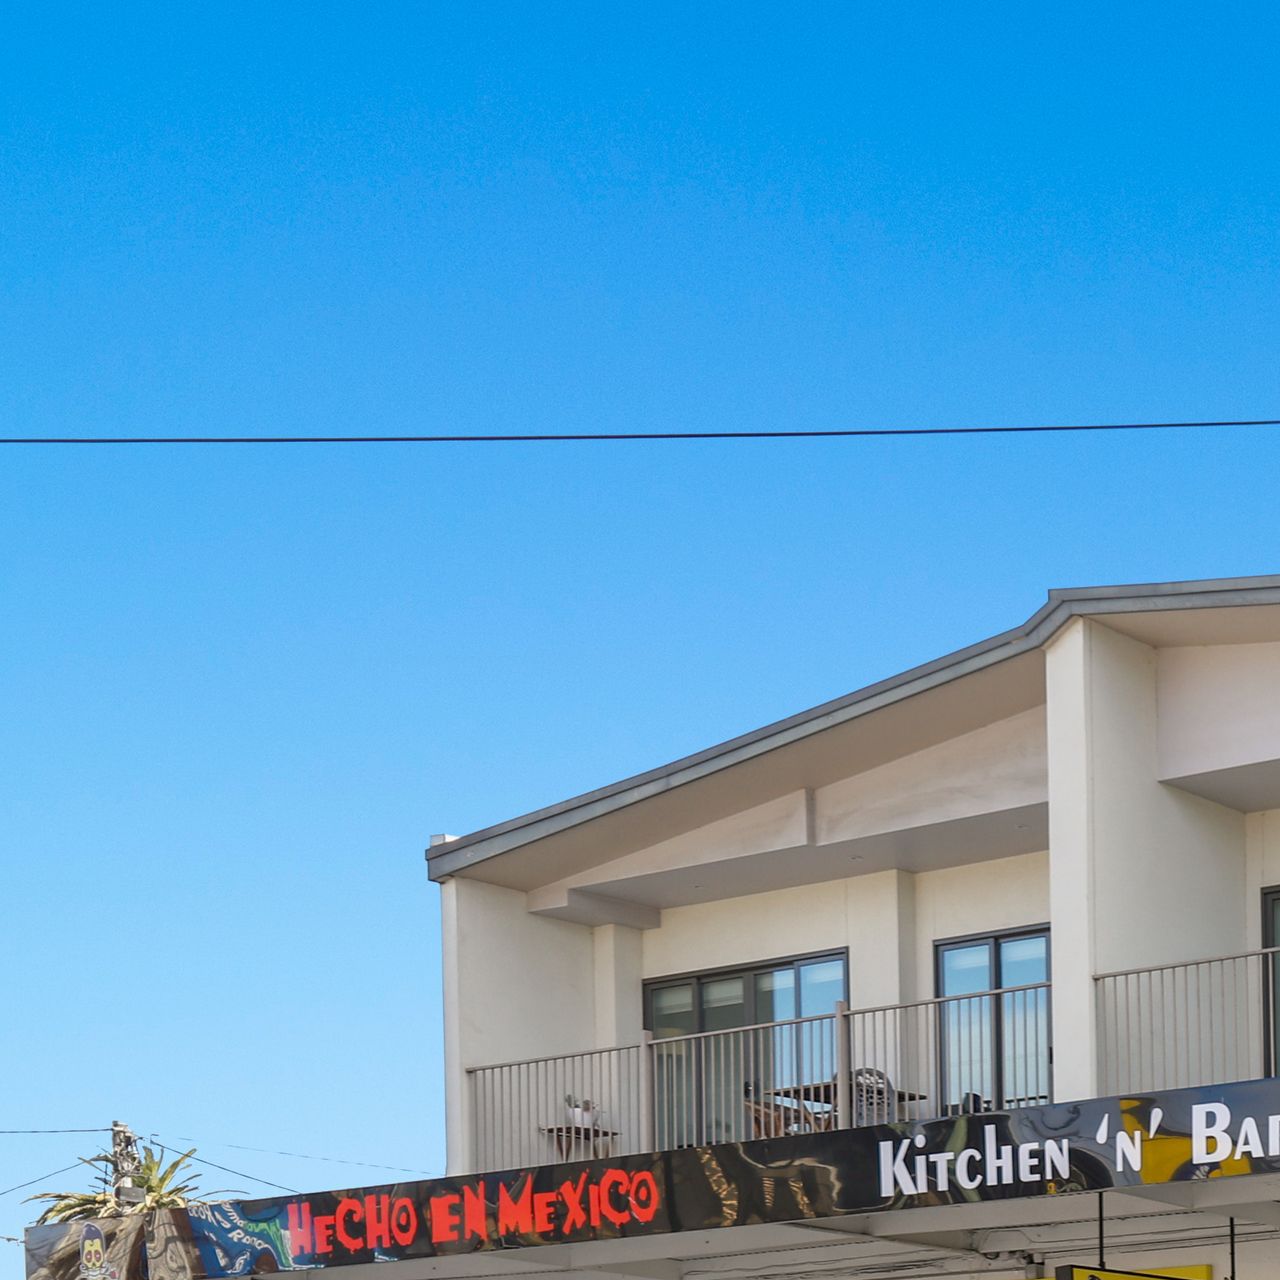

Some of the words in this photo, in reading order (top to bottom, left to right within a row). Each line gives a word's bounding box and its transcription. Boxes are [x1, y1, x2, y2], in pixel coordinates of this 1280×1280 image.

[287, 1193, 418, 1256] HECHO
[430, 1180, 488, 1243] EN
[498, 1168, 660, 1236] MEXICO
